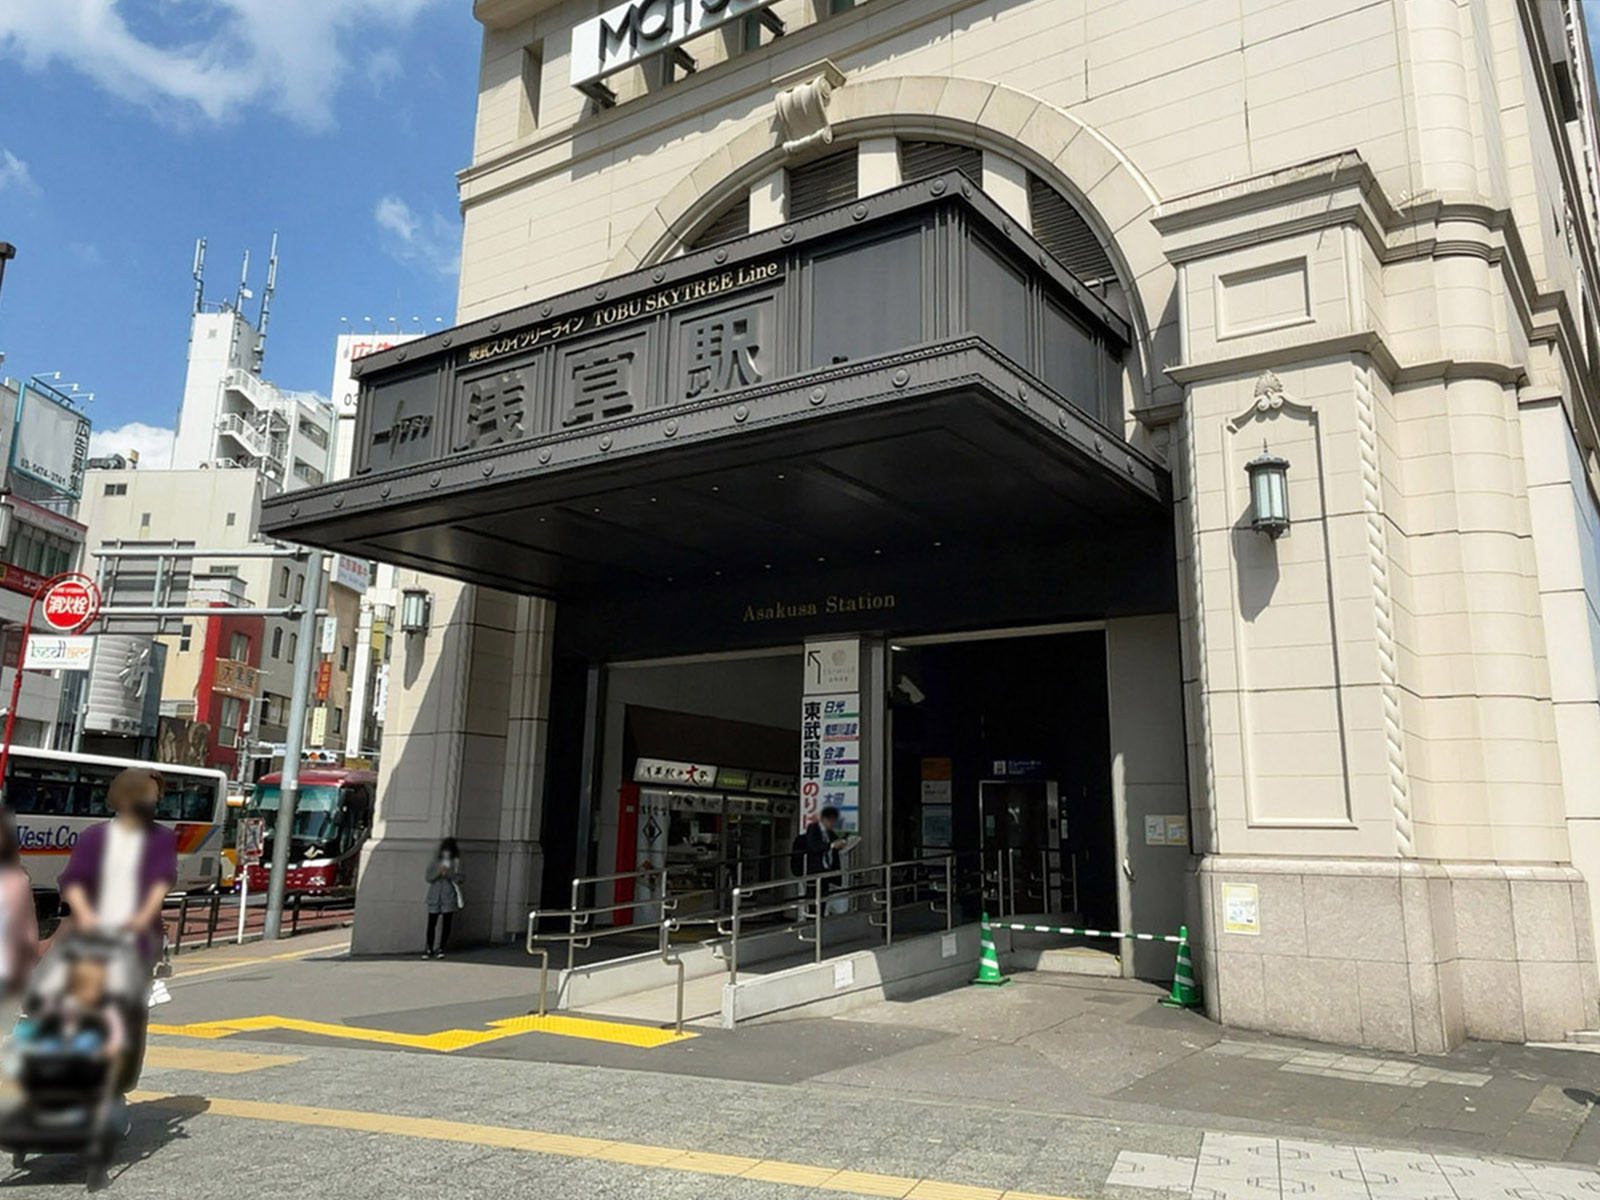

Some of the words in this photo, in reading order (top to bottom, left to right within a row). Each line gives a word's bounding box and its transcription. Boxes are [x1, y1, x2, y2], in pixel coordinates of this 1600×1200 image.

[467, 316, 585, 363] 東武スカイツリーライン
[593, 298, 642, 328] TOBU
[645, 272, 733, 313] SKYTREE
[738, 260, 778, 285] Line
[47, 595, 88, 615] 消火栓
[743, 602, 817, 623] Asakusa
[825, 593, 896, 614] Station
[824, 700, 846, 714] 日光
[824, 746, 846, 760] 会津
